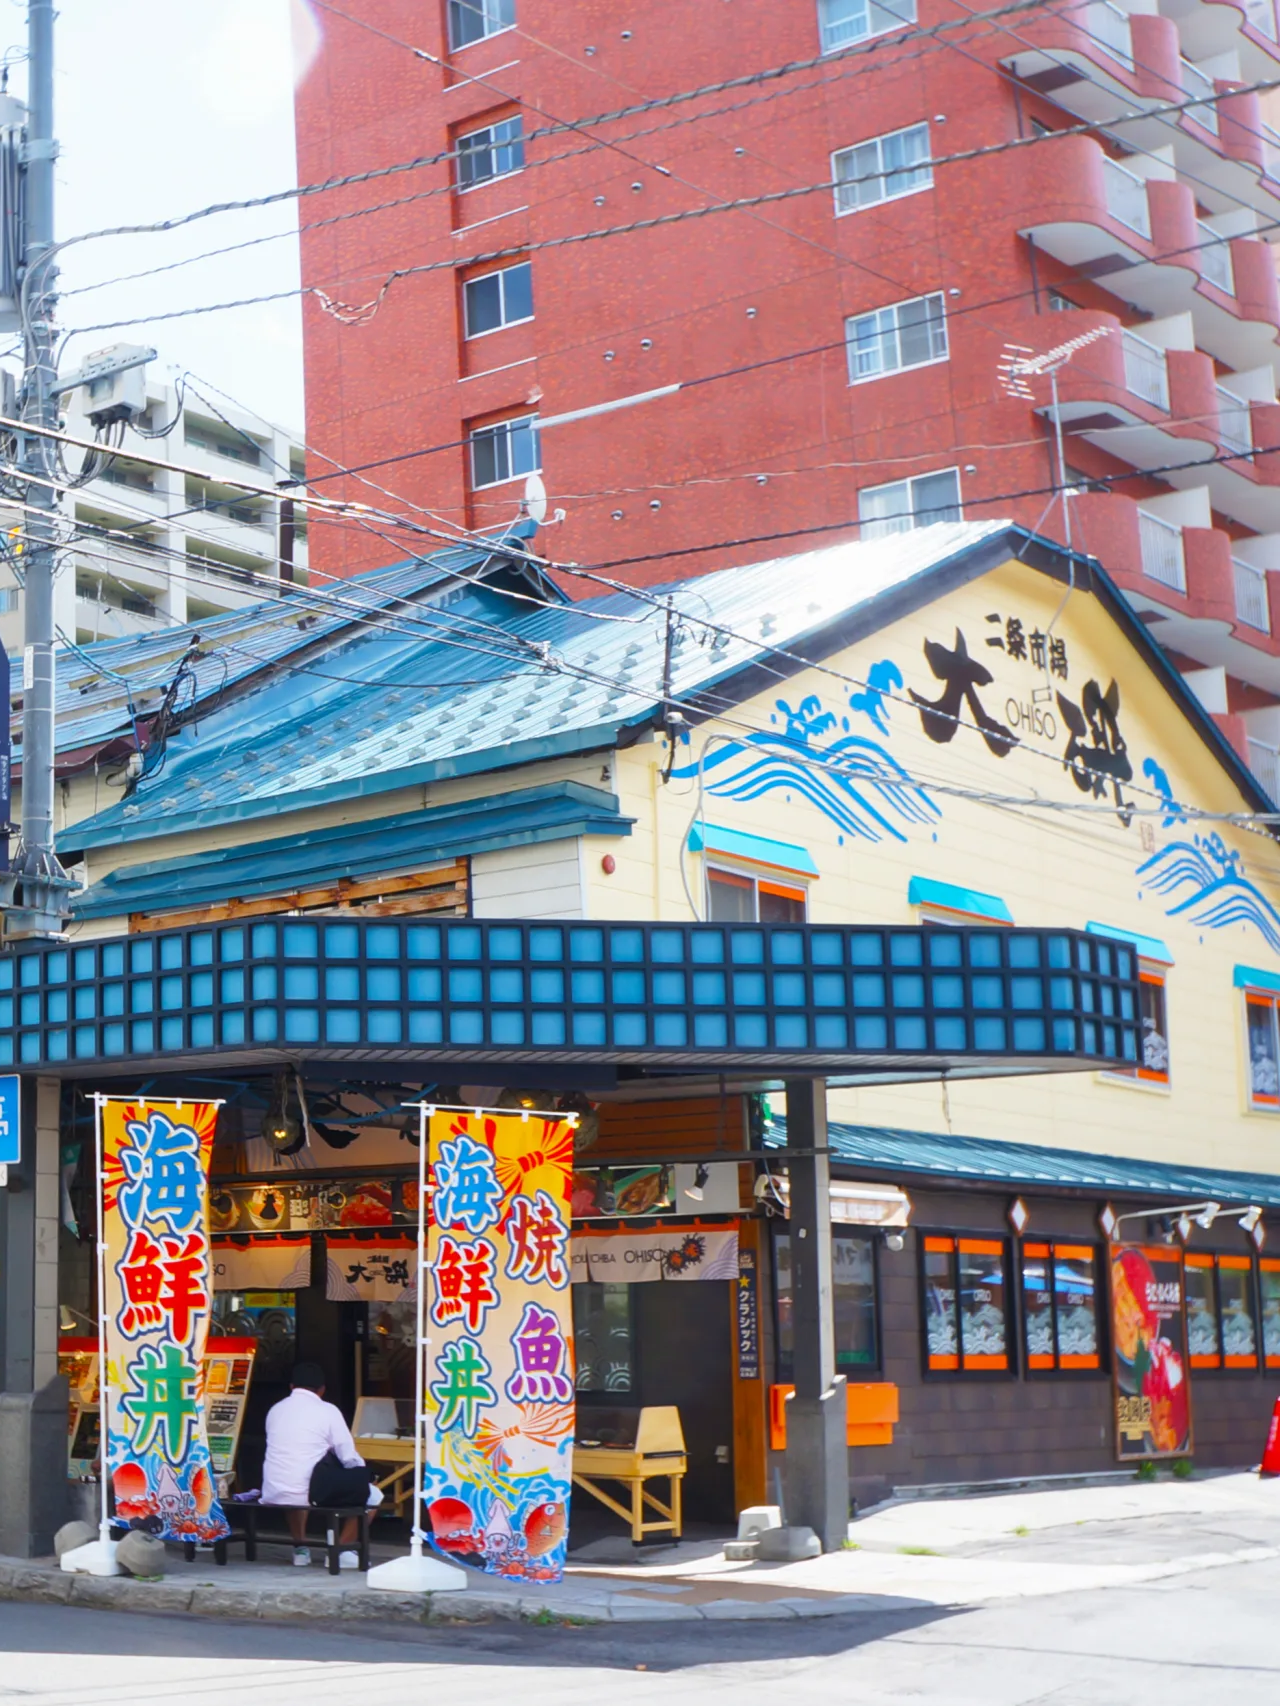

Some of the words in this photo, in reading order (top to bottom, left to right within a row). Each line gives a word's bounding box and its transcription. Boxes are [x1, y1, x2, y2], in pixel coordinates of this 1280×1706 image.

[1005, 697, 1057, 741] OHISO
[118, 1111, 209, 1467] 海鮮丼
[433, 1134, 504, 1438] 海鮮丼
[504, 1190, 573, 1405] 焼魚
[624, 1248, 664, 1264] OHISO
[739, 1290, 751, 1352] クラシック
